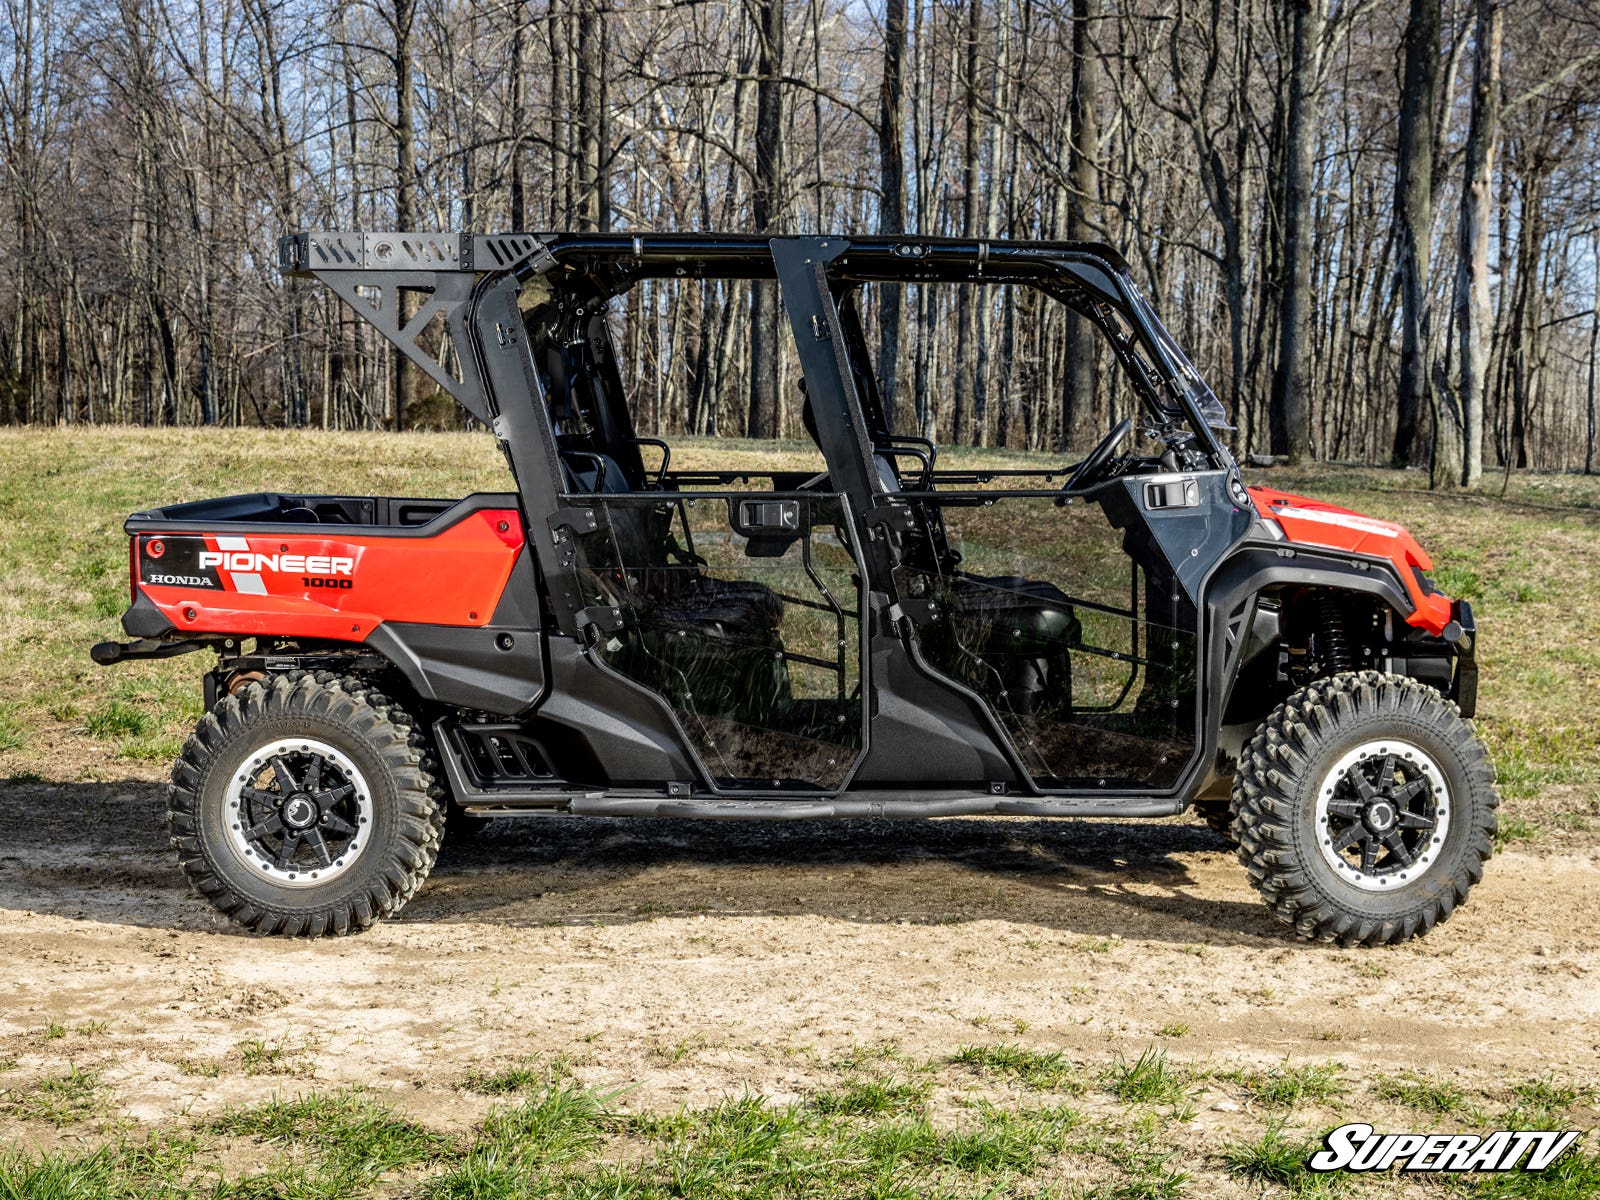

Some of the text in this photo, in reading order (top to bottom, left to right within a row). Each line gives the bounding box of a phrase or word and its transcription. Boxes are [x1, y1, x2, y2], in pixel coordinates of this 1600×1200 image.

[199, 551, 353, 575] PIONEER
[149, 574, 214, 586] HONDA
[302, 577, 353, 589] 1000
